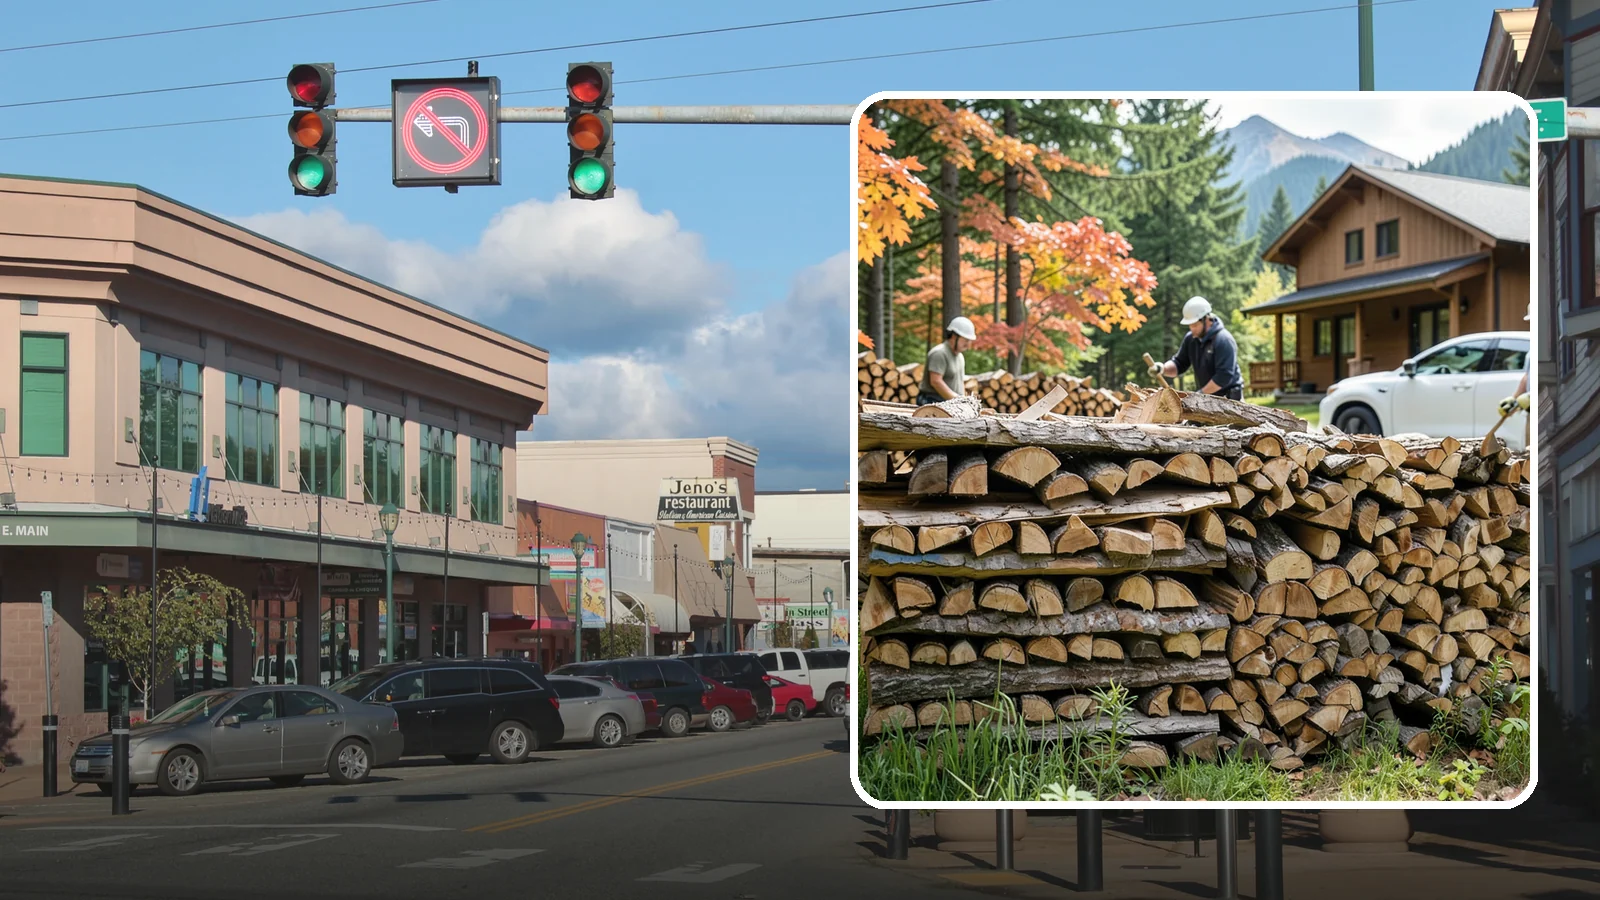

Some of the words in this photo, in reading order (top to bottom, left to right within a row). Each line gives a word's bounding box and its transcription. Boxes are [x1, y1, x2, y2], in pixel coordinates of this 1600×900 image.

[670, 480, 727, 494] Jeno's
[665, 497, 731, 509] restaurant
[686, 510, 714, 519] American
[2, 525, 13, 536] E.
[15, 525, 49, 536] MAIN
[797, 607, 828, 616] Street
